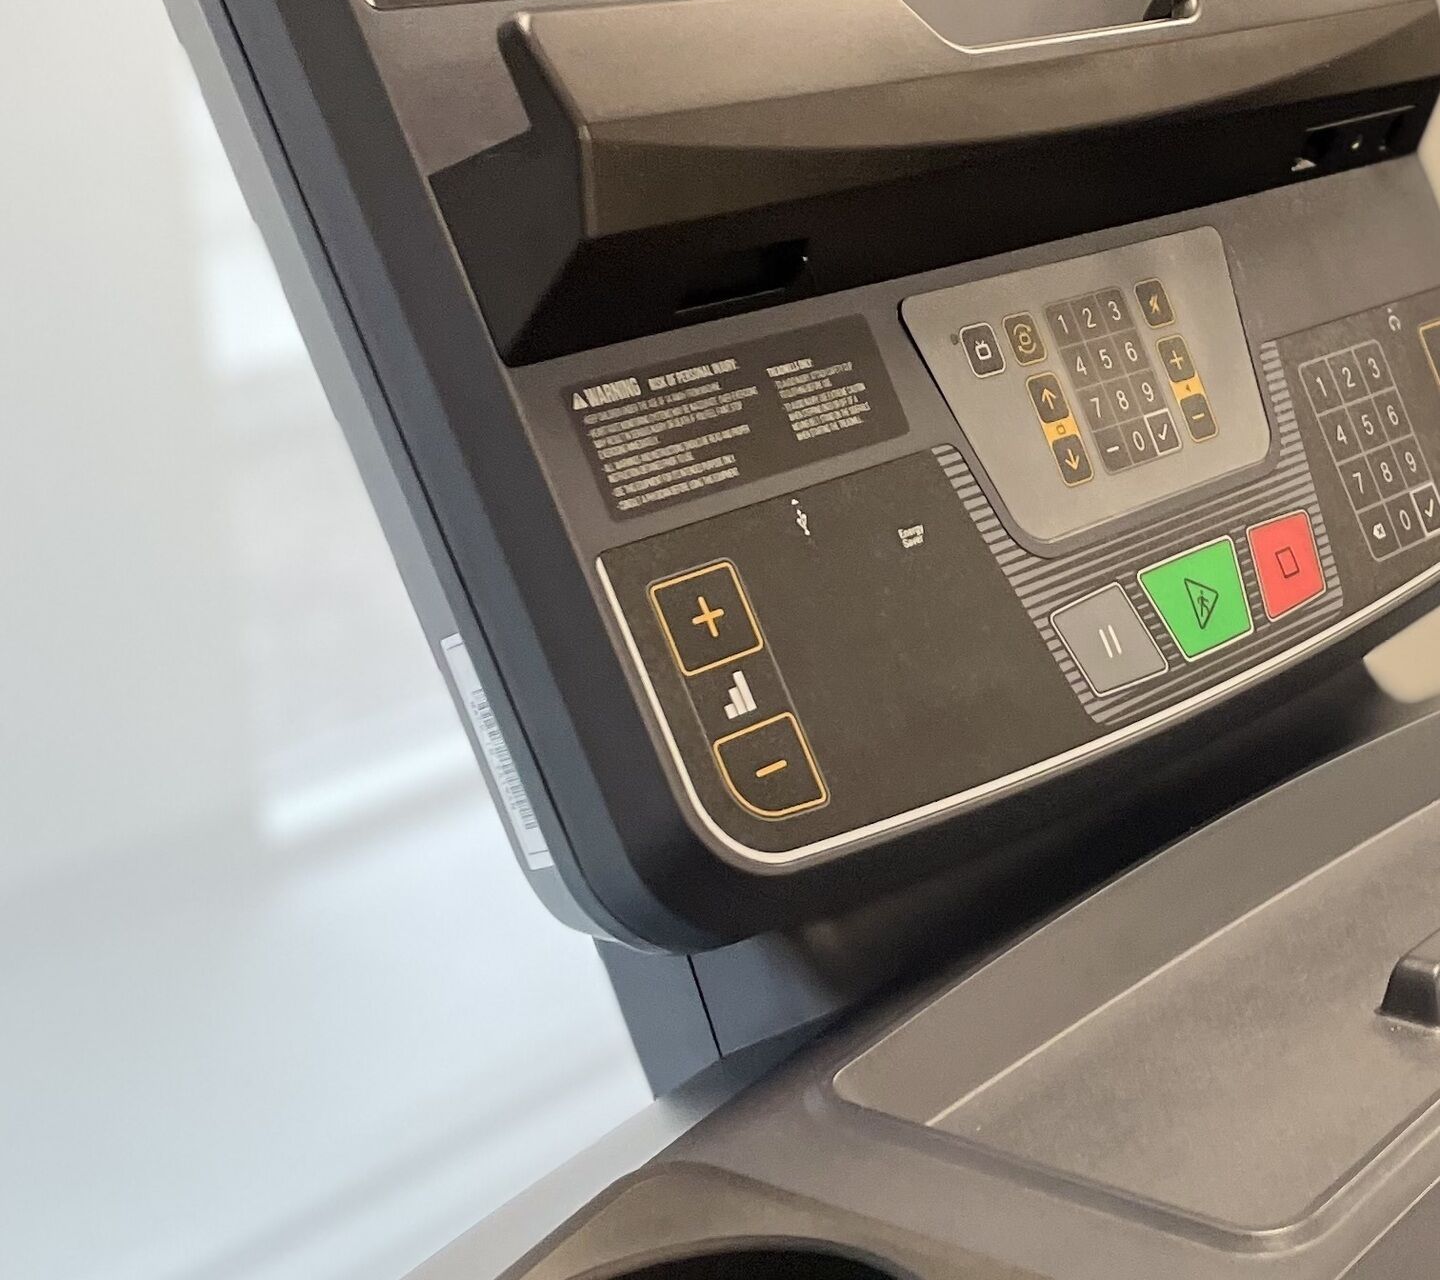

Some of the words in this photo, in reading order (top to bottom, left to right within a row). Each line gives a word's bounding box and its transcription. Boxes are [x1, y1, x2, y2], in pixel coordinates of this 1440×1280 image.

[1058, 314, 1069, 334] 1
[1082, 308, 1096, 328] 2
[1107, 301, 1122, 321] 3
[1076, 356, 1087, 376] 4
[1099, 349, 1113, 369] 5
[1124, 341, 1138, 362] 6
[1315, 376, 1328, 397] 1
[1342, 367, 1356, 388] 2
[1367, 357, 1381, 378] 3
[1090, 397, 1102, 418] 7
[1115, 390, 1129, 410] 8
[1141, 382, 1154, 402] 9
[1132, 431, 1145, 452] 0
[1336, 424, 1348, 445] 4
[1361, 414, 1374, 435] 5
[1386, 404, 1399, 425] 6
[1352, 472, 1364, 494] 7
[1380, 462, 1393, 483] 8
[1404, 451, 1417, 473] 9
[1399, 509, 1411, 531] 0
